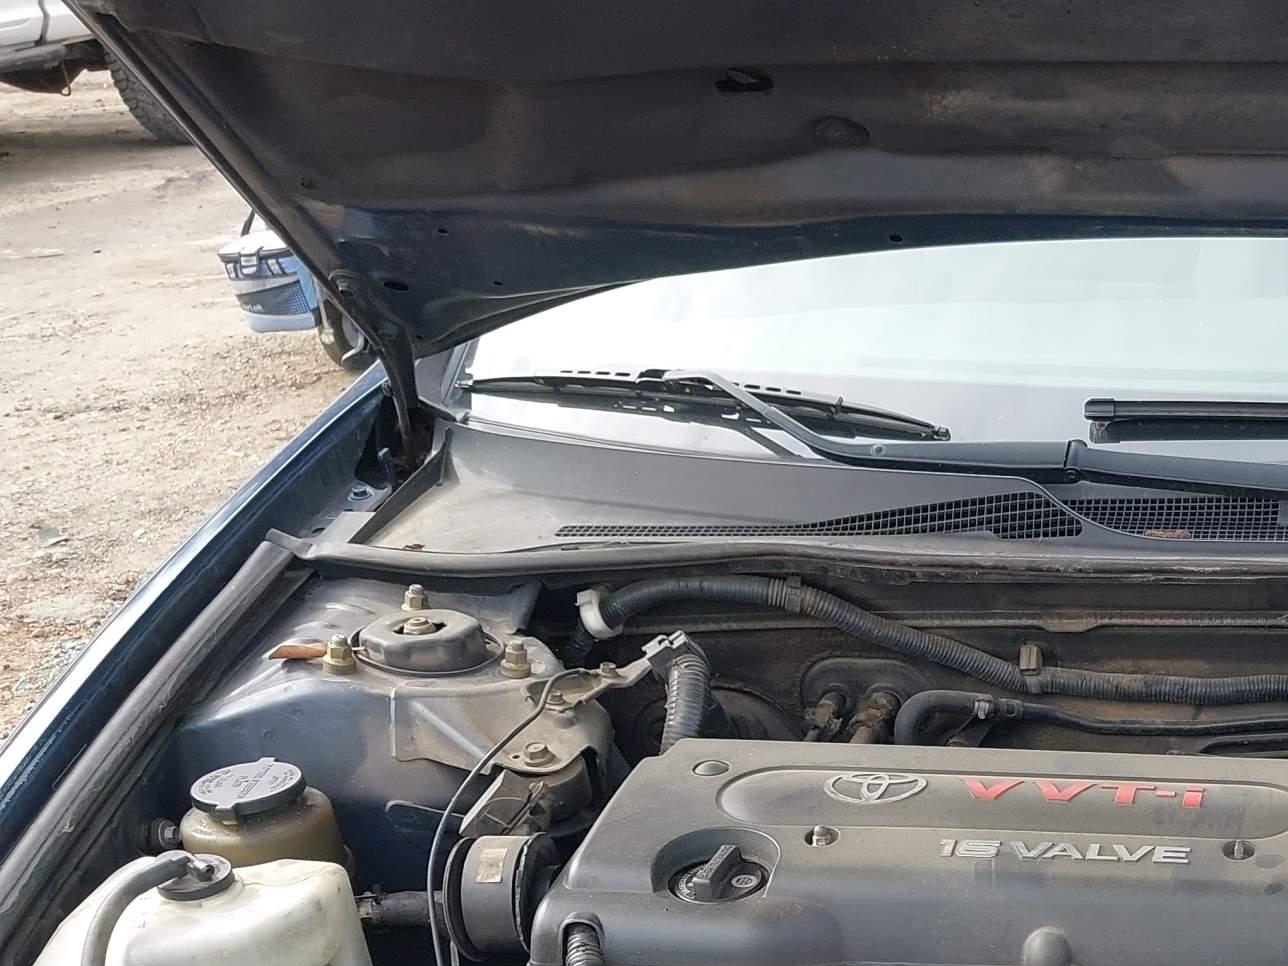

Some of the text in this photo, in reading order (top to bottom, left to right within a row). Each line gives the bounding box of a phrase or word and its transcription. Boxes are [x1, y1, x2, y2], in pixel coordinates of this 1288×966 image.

[961, 777, 1207, 808] VVT-i
[938, 839, 1192, 865] 16 VALVE
